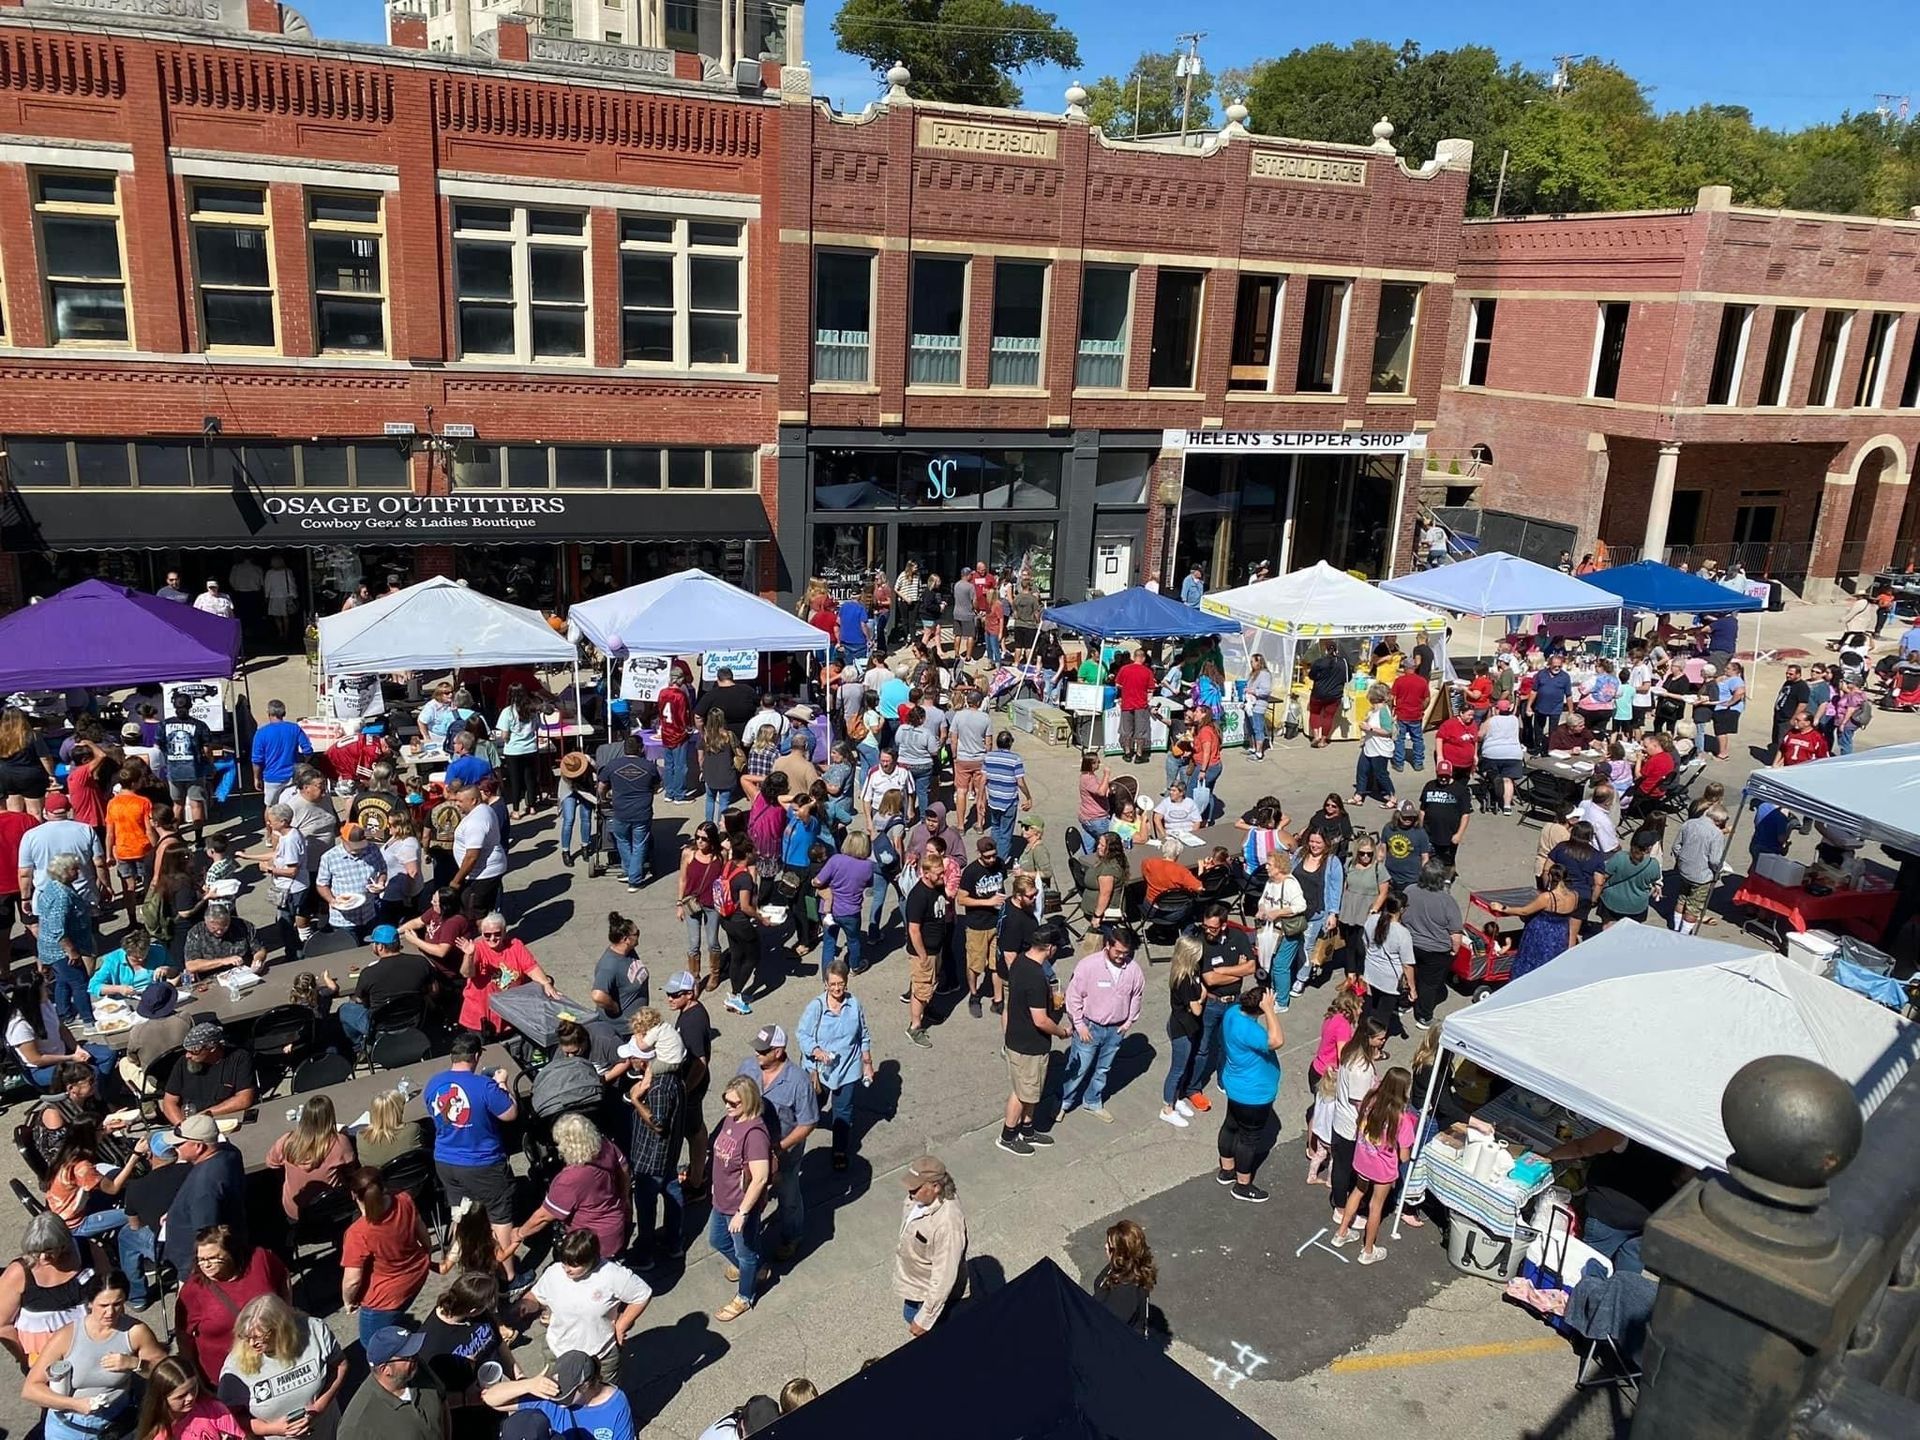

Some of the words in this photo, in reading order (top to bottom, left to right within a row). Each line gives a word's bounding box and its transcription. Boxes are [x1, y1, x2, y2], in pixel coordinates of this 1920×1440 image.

[934, 126, 1047, 155] PATTERSON
[1188, 431, 1261, 447] HELEN'S
[1272, 432, 1353, 447] SLIPPER
[1359, 433, 1405, 447] SHOP
[927, 459, 957, 499] SC
[262, 496, 371, 515] OSAGE
[378, 496, 566, 515] OUTFITTERS
[300, 517, 362, 531] Cowboy
[364, 517, 402, 529] Gear
[404, 517, 418, 529] &
[420, 517, 468, 529] Ladies
[471, 517, 537, 530] Boutique
[1343, 625, 1359, 633] THE
[1360, 624, 1387, 632] LEMON
[1387, 623, 1407, 631] SEED
[721, 652, 739, 662] and
[633, 675, 660, 684] People's
[634, 682, 656, 690] Choice
[638, 689, 652, 699] 16
[662, 702, 673, 724] 4
[276, 1364, 312, 1387] PAWHUSKA
